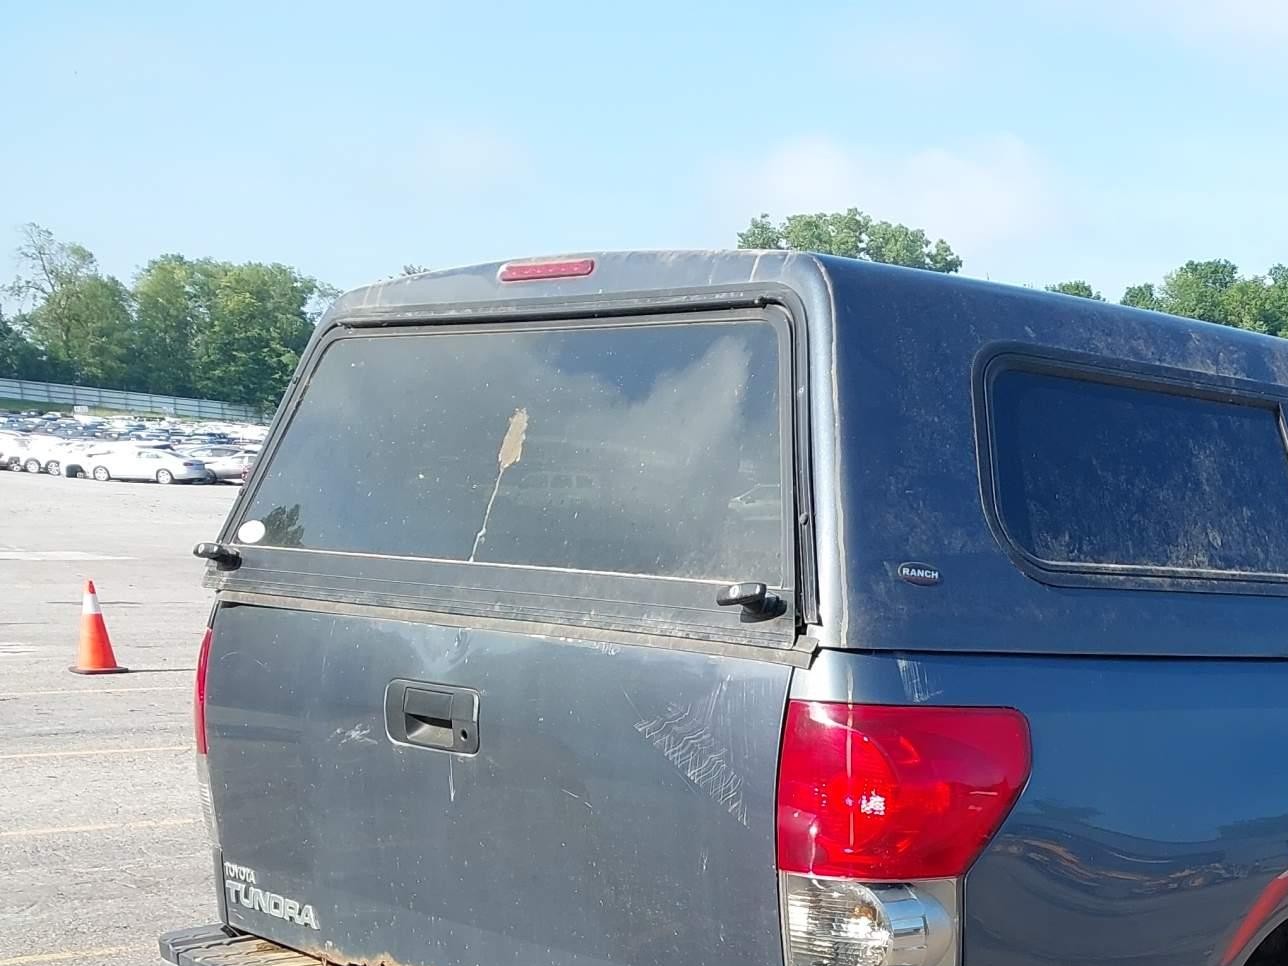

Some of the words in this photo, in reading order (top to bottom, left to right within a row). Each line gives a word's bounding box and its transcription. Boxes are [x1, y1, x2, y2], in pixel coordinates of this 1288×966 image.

[902, 567, 939, 579] RANCH
[224, 861, 256, 884] TOYOTA
[225, 880, 320, 931] TUNDRA
